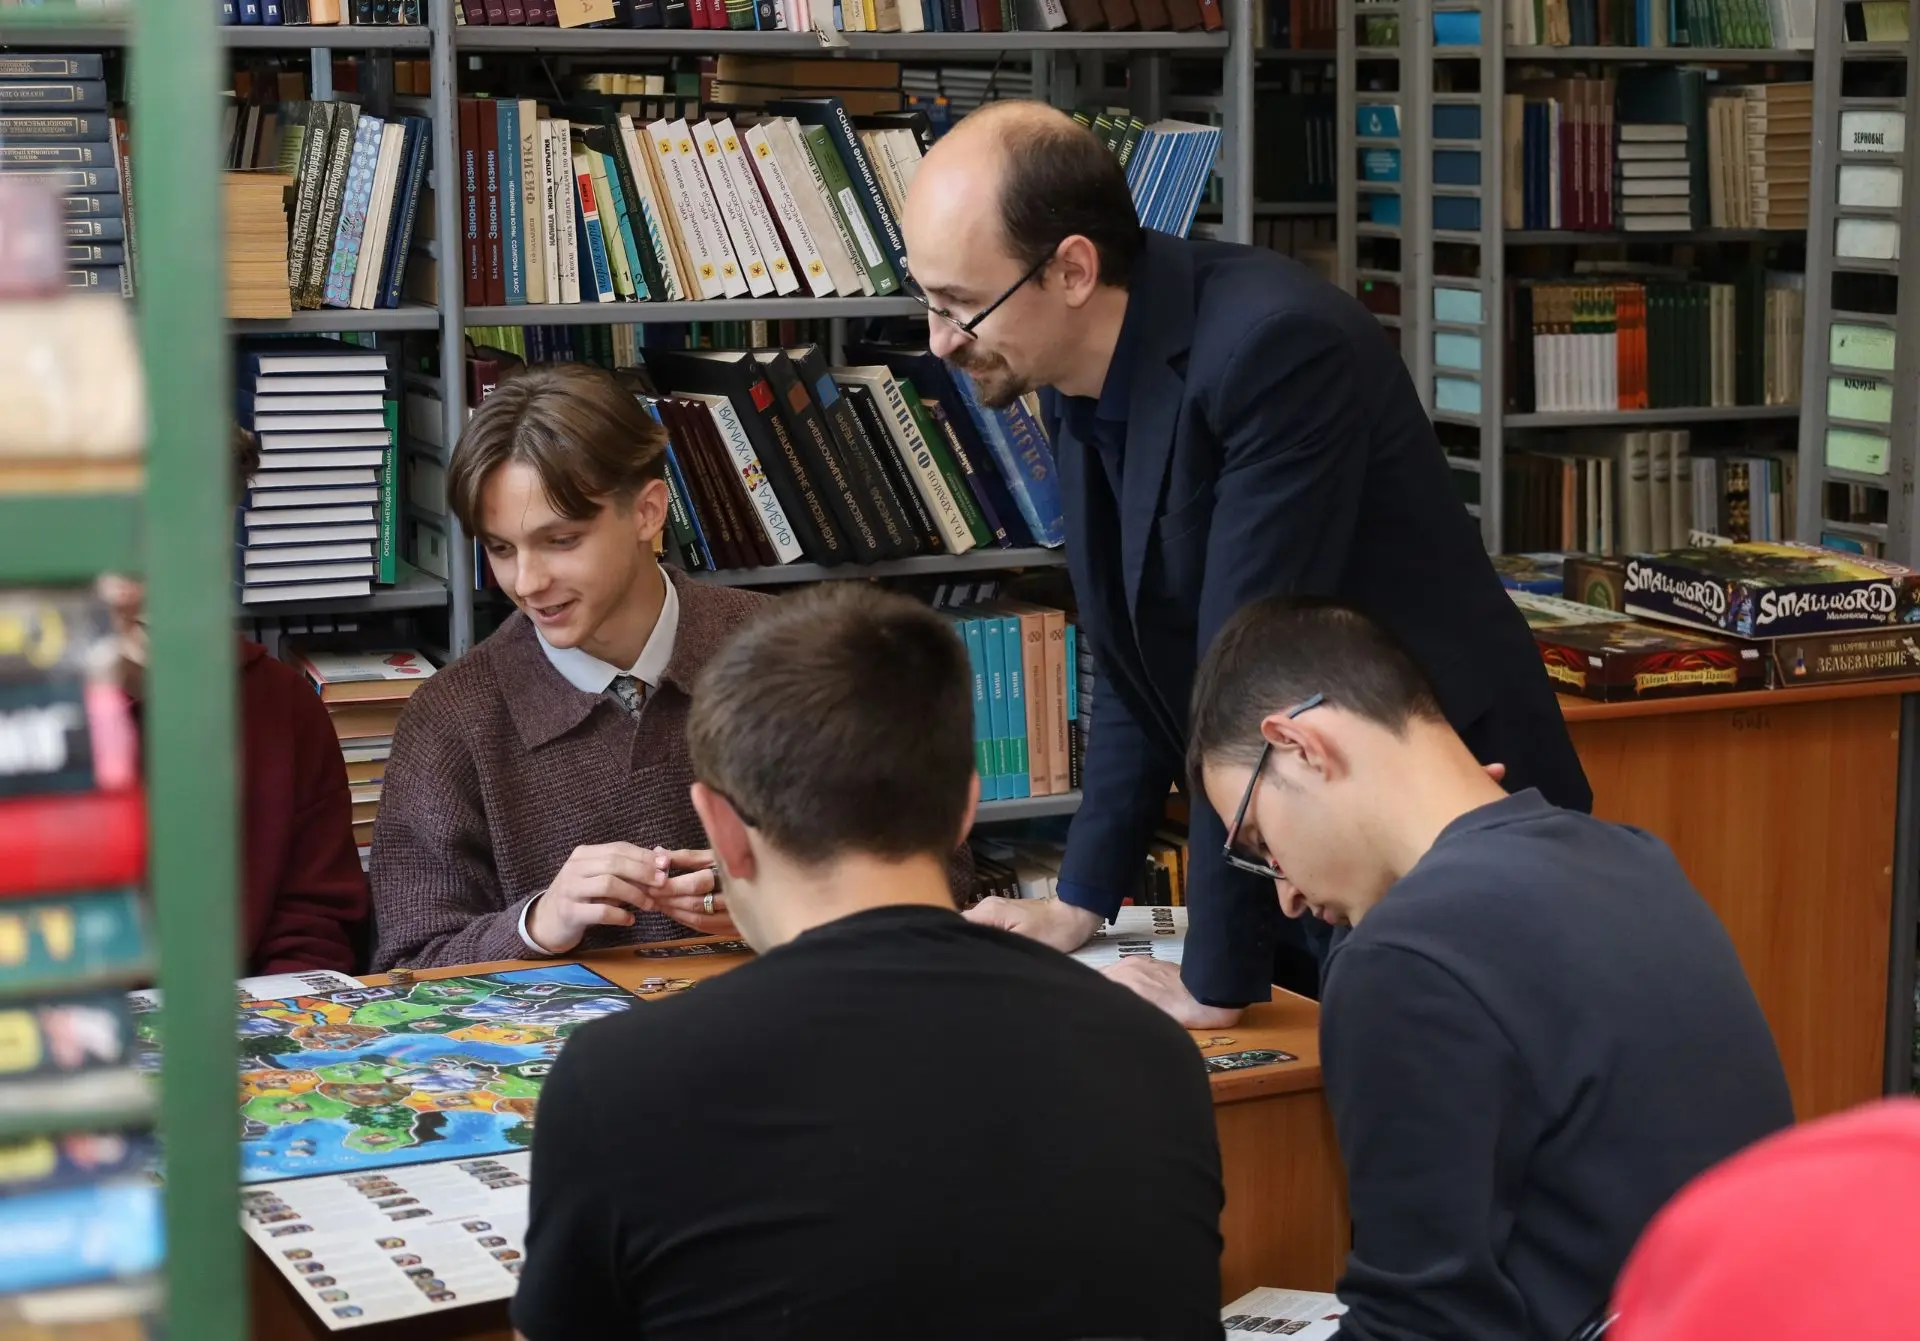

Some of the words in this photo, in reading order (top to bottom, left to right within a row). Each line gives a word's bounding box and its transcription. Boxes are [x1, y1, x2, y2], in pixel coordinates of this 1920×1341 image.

[836, 108, 856, 148] ОСНОВЫ
[1854, 132, 1884, 145] ЗЕРНОВЫЕ
[302, 127, 325, 199] ПРИРОДОВЕДЕНИЮ
[327, 127, 351, 199] ПРИРОДОВЕДЕНИЮ
[467, 151, 476, 192] физики
[487, 151, 497, 192] физики
[524, 134, 535, 205] ФИЗИКА
[545, 139, 553, 176] ОТКРЫТИЯ
[563, 159, 568, 168] ПО
[671, 158, 686, 189] ФИЗИКИ
[691, 158, 704, 189] ФИЗИКИ
[717, 158, 732, 189] ФИЗИКИ
[738, 156, 753, 186] ФИЗИКИ
[770, 161, 786, 192] ФИЗИКИ
[853, 148, 873, 186] ФИЗИКИ
[301, 199, 313, 211] ПО
[325, 198, 336, 210] ПО
[508, 180, 516, 216] НЕЛИНЕЙНЫЕ
[749, 199, 758, 217] КУРС
[870, 185, 876, 196] И
[468, 196, 476, 239] Законы
[489, 196, 497, 239] Законы
[678, 202, 688, 220] КУРС
[682, 190, 708, 257] МАТЕМАТИЧЕСКОЙ
[699, 202, 708, 220] КУРС
[702, 190, 730, 257] МАТЕМАТИЧЕСКОЙ
[726, 201, 736, 220] КУРС
[730, 189, 757, 256] МАТЕМАТИЧЕСКОЙ
[750, 186, 781, 252] МАТЕМАТИЧЕСКОЙ
[781, 202, 792, 222] КУРС
[783, 192, 815, 255] МАТЕМАТИЧЕСКОЙ
[826, 194, 847, 232] мембранах
[872, 193, 902, 251] БИОФИЗИКИ
[294, 212, 311, 252] ПРАКТИКА
[317, 211, 333, 251] ПРАКТИКА
[289, 252, 305, 287] ПОЛЕВАЯ
[310, 251, 326, 286] ПОЛЕВАЯ
[624, 271, 628, 281] 1
[845, 239, 866, 277] Диффузия
[635, 274, 643, 284] 2
[717, 404, 750, 457] ХИМИЯ
[880, 377, 933, 470] ФИЗИКИ
[943, 420, 963, 452] Эйнштейн
[769, 414, 812, 490] ЭНЦИКЛОПЕДИЯ
[806, 415, 849, 491] ЭНЦИКЛОПЕДИЯ
[957, 449, 975, 475] Альберт
[925, 468, 954, 515] ХРАМОВ
[755, 485, 795, 548] ФИЗИКА
[804, 490, 840, 551] ФИЗИЧЕСКАЯ
[843, 490, 879, 550] ФИЗИЧЕСКАЯ
[947, 513, 966, 539] Ю.А.
[1870, 612, 1886, 621] мир
[1817, 651, 1907, 673] ЗЕЛЬЕВАРЕНИЕ
